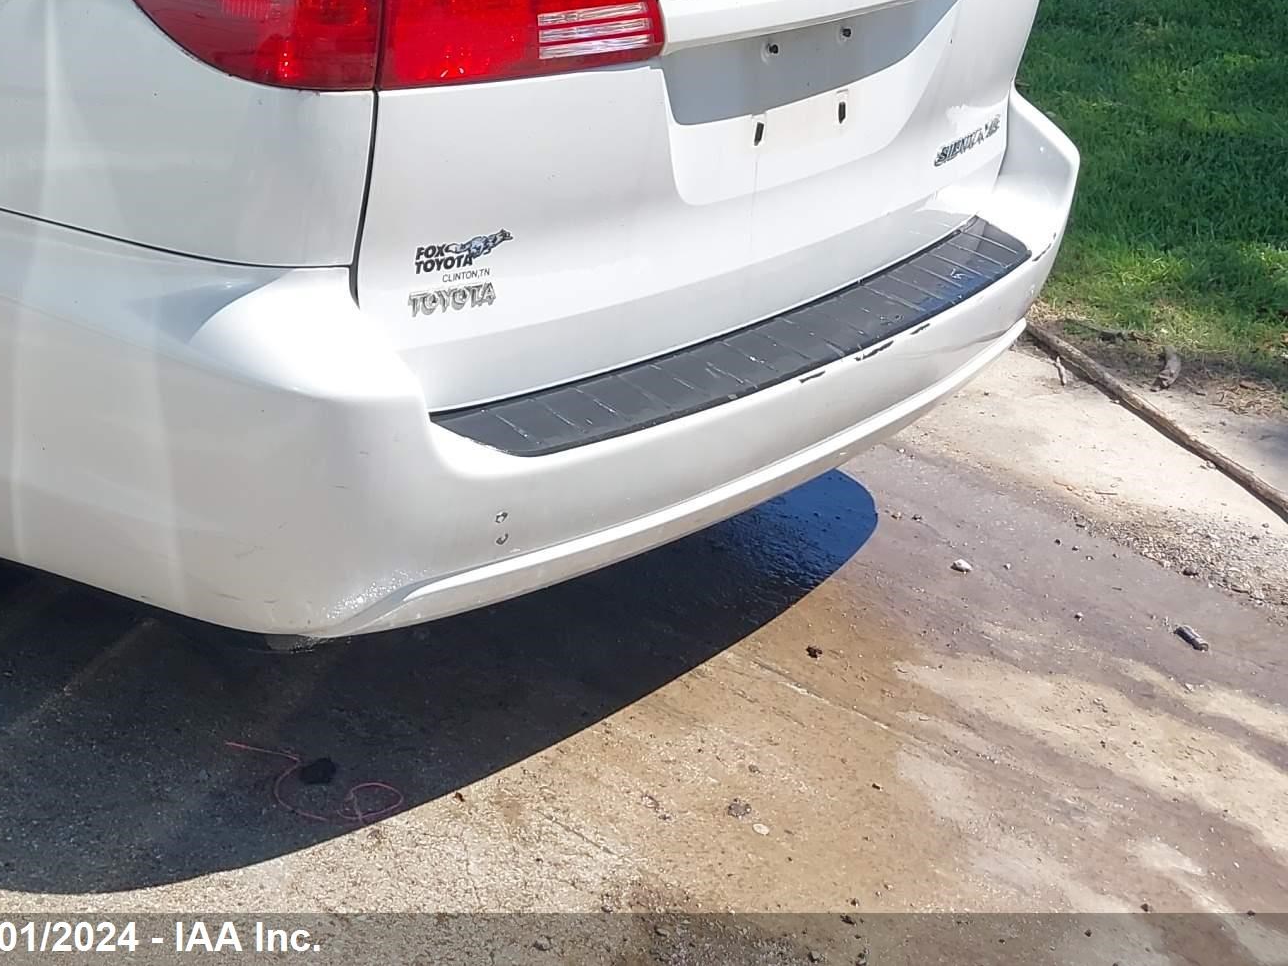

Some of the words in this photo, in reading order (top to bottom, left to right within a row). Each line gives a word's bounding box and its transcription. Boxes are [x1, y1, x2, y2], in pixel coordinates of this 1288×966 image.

[415, 243, 446, 260] FOX
[415, 253, 473, 274] TOYOTA
[408, 282, 496, 318] TOYOTA
